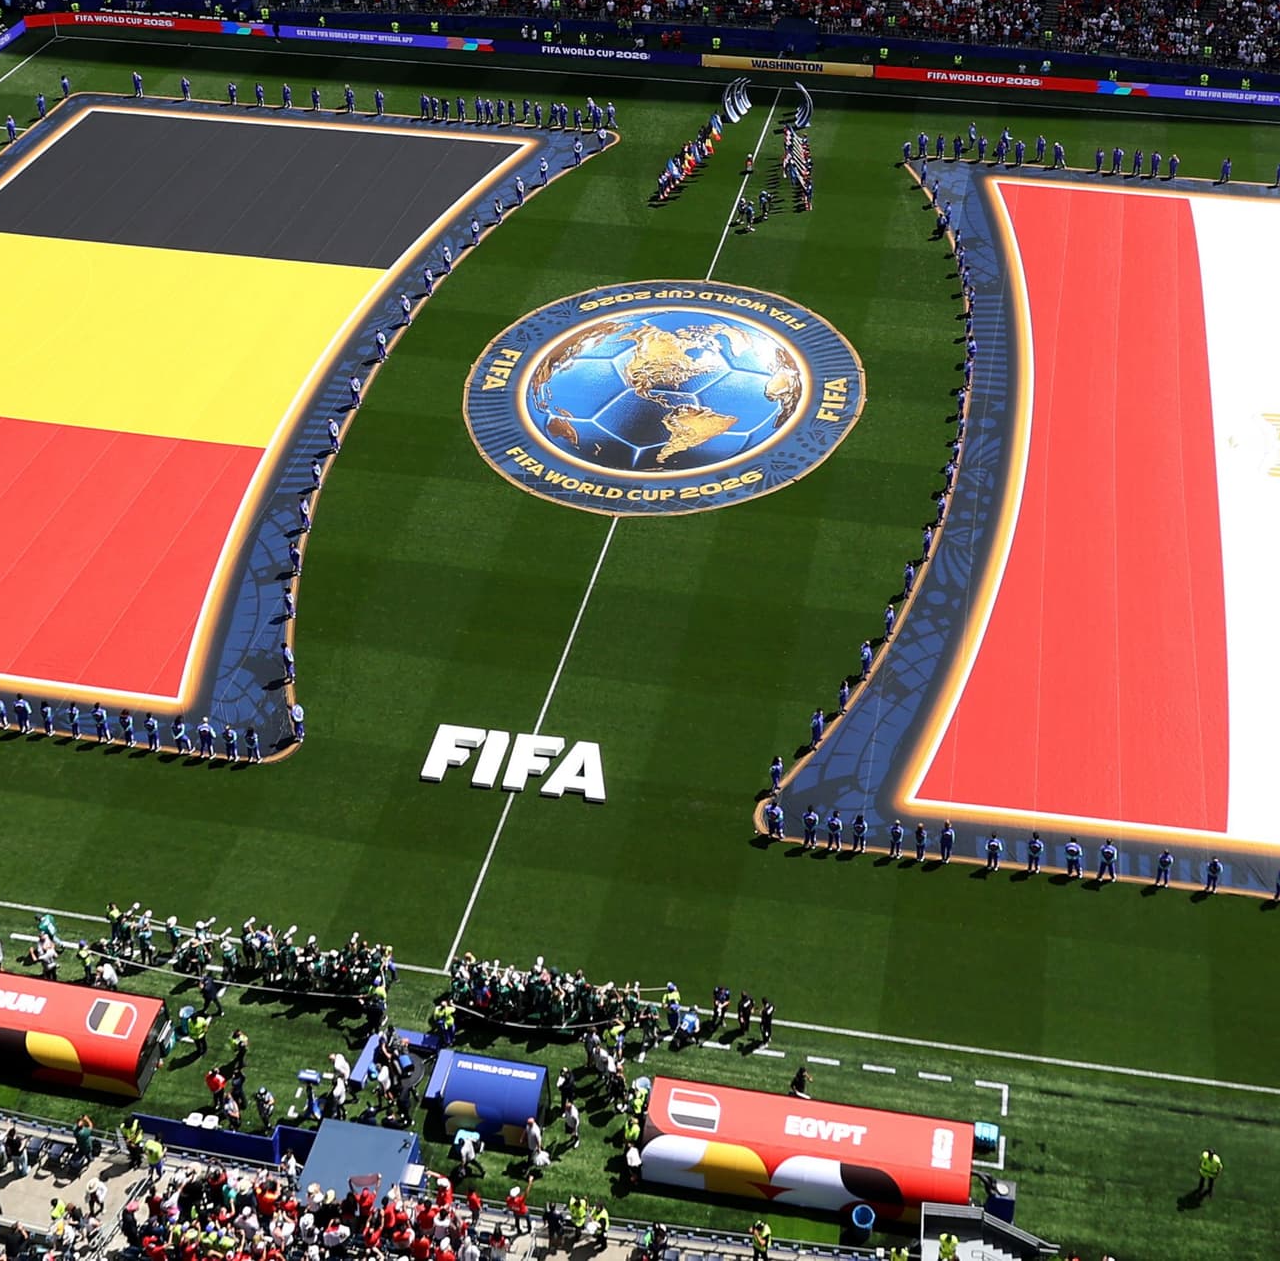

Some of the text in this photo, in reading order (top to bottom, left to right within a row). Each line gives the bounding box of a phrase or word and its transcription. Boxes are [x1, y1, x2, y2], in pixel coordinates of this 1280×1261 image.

[75, 14, 94, 23] FIFA
[94, 16, 125, 25] WORLD
[125, 18, 143, 26] CUP
[541, 45, 562, 55] FIFA
[562, 47, 595, 57] WORLD
[596, 49, 615, 58] CUP
[751, 59, 824, 73] WASHINGTON
[927, 72, 949, 81] FIFA
[949, 73, 984, 83] WORLD
[985, 75, 1006, 85] CUP
[578, 290, 808, 331] FIFA WORLD CUP 2026
[482, 348, 523, 391] FIFA
[816, 377, 849, 422] FIFA
[505, 446, 764, 501] FIFA WORLD CUP 2026
[419, 723, 608, 804] FIFA
[457, 1059, 537, 1081] FIFA WORLD CUP 2026
[784, 1115, 868, 1146] EGYPT
